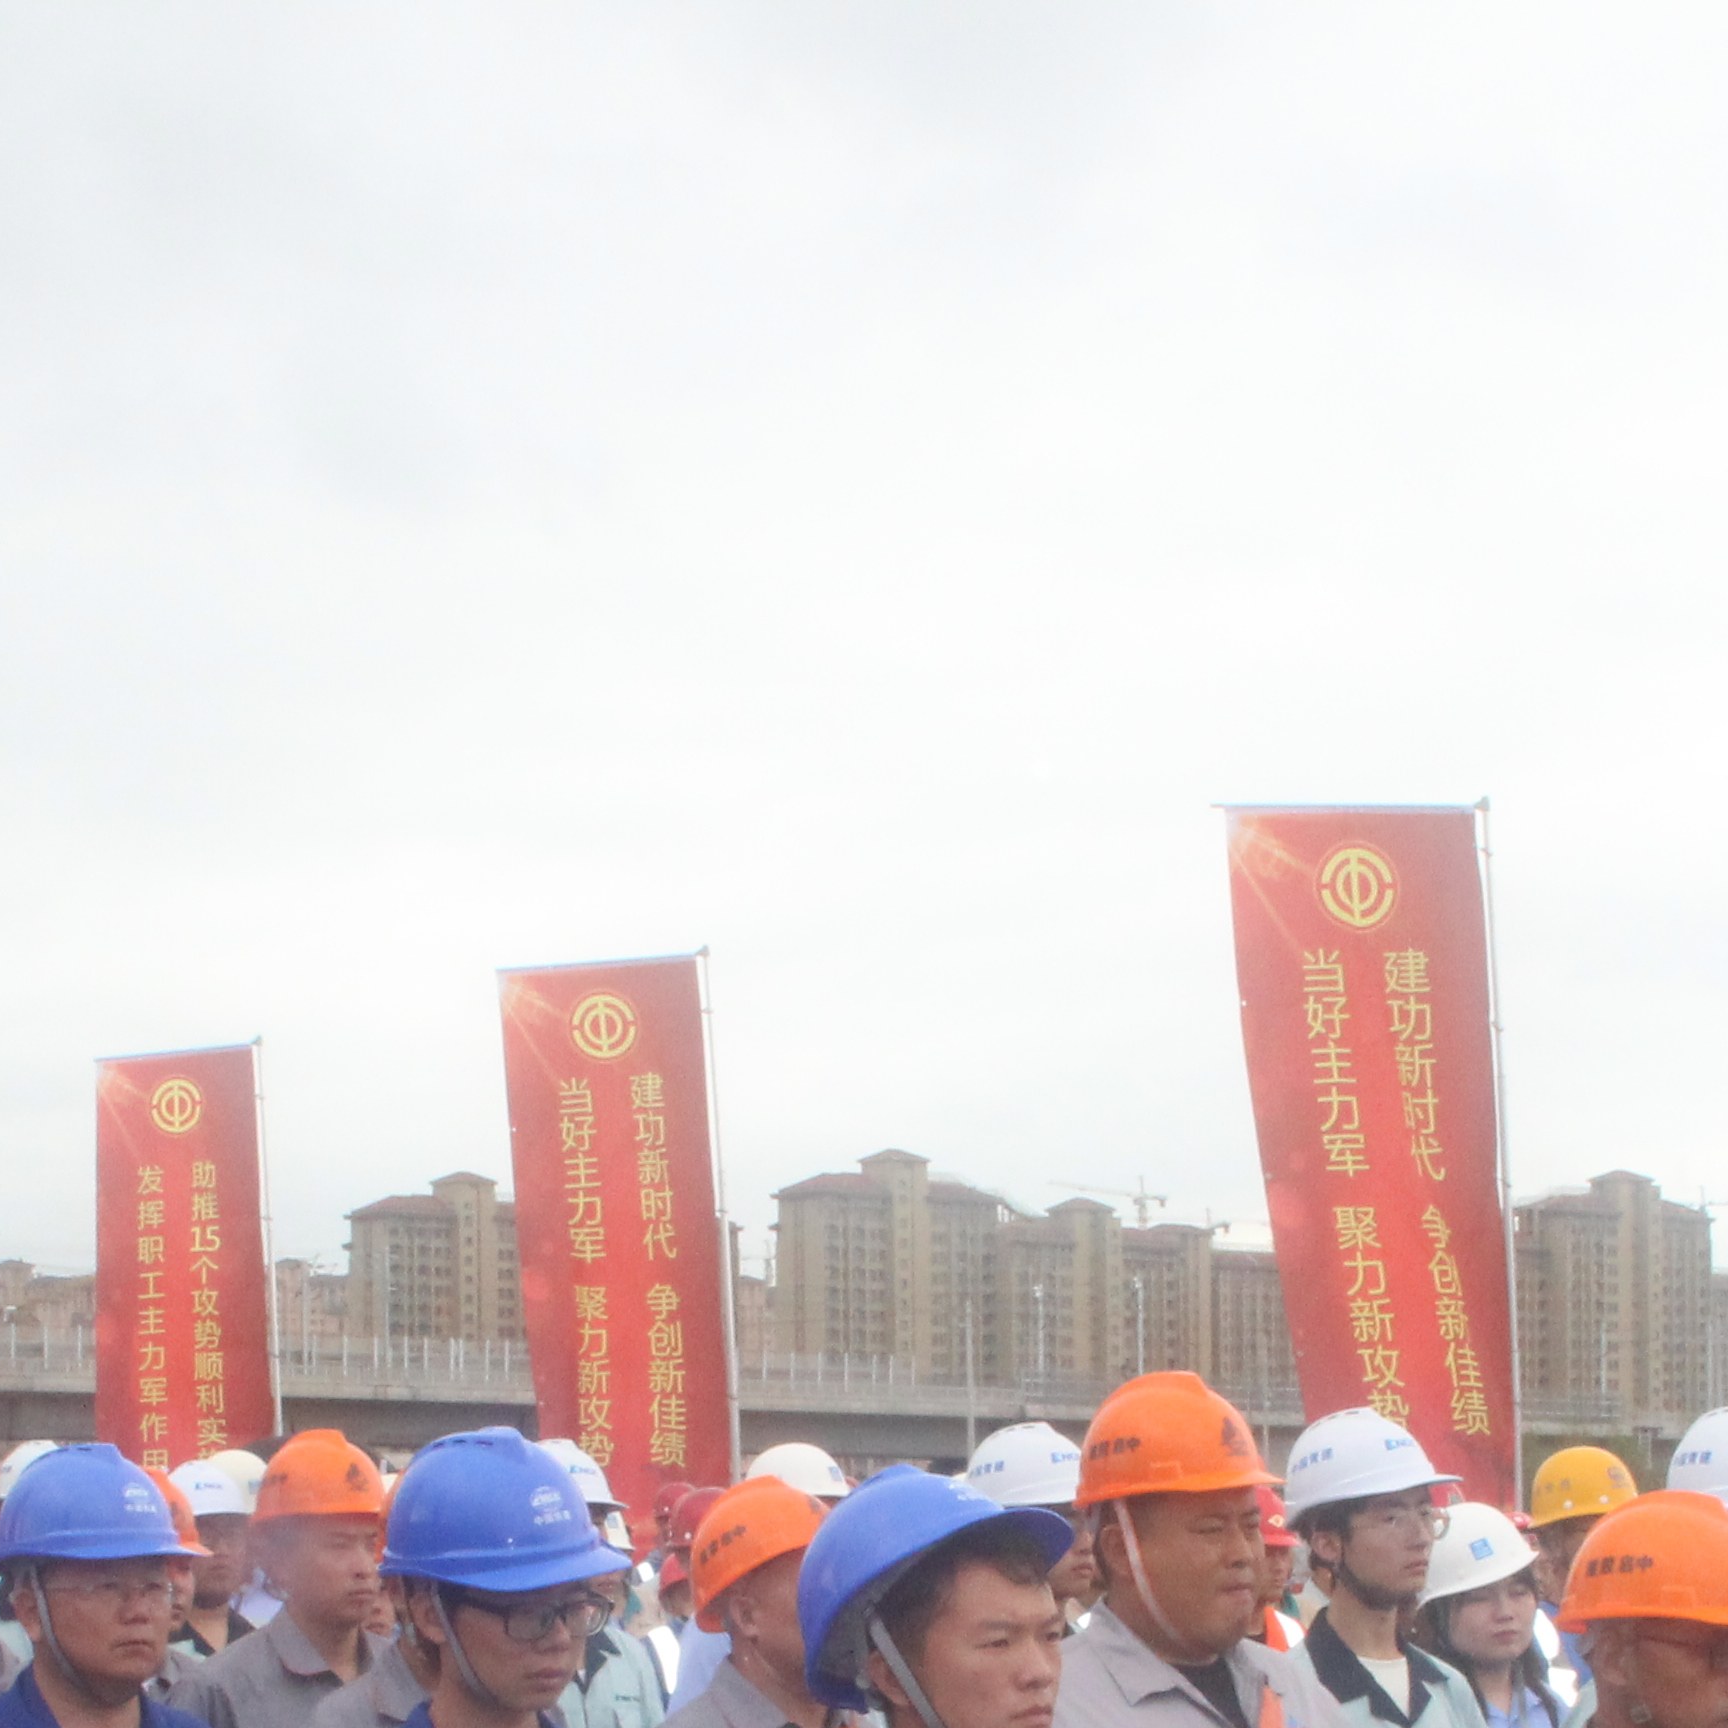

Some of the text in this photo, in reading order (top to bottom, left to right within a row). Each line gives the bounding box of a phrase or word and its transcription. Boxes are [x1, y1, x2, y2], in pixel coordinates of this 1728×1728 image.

[1302, 948, 1369, 1178] 当好主力军
[1384, 948, 1491, 1436] 建功新时代 争创新佳绩
[137, 1164, 170, 1470] 发挥职工主力军作用
[189, 1160, 228, 1460] 助推15个攻势顺利实
[558, 1077, 614, 1468] 当好主力军 聚力新攻势
[629, 1072, 687, 1468] 建功新时代 争创新佳绩
[1333, 1206, 1410, 1431] 聚力新攻势
